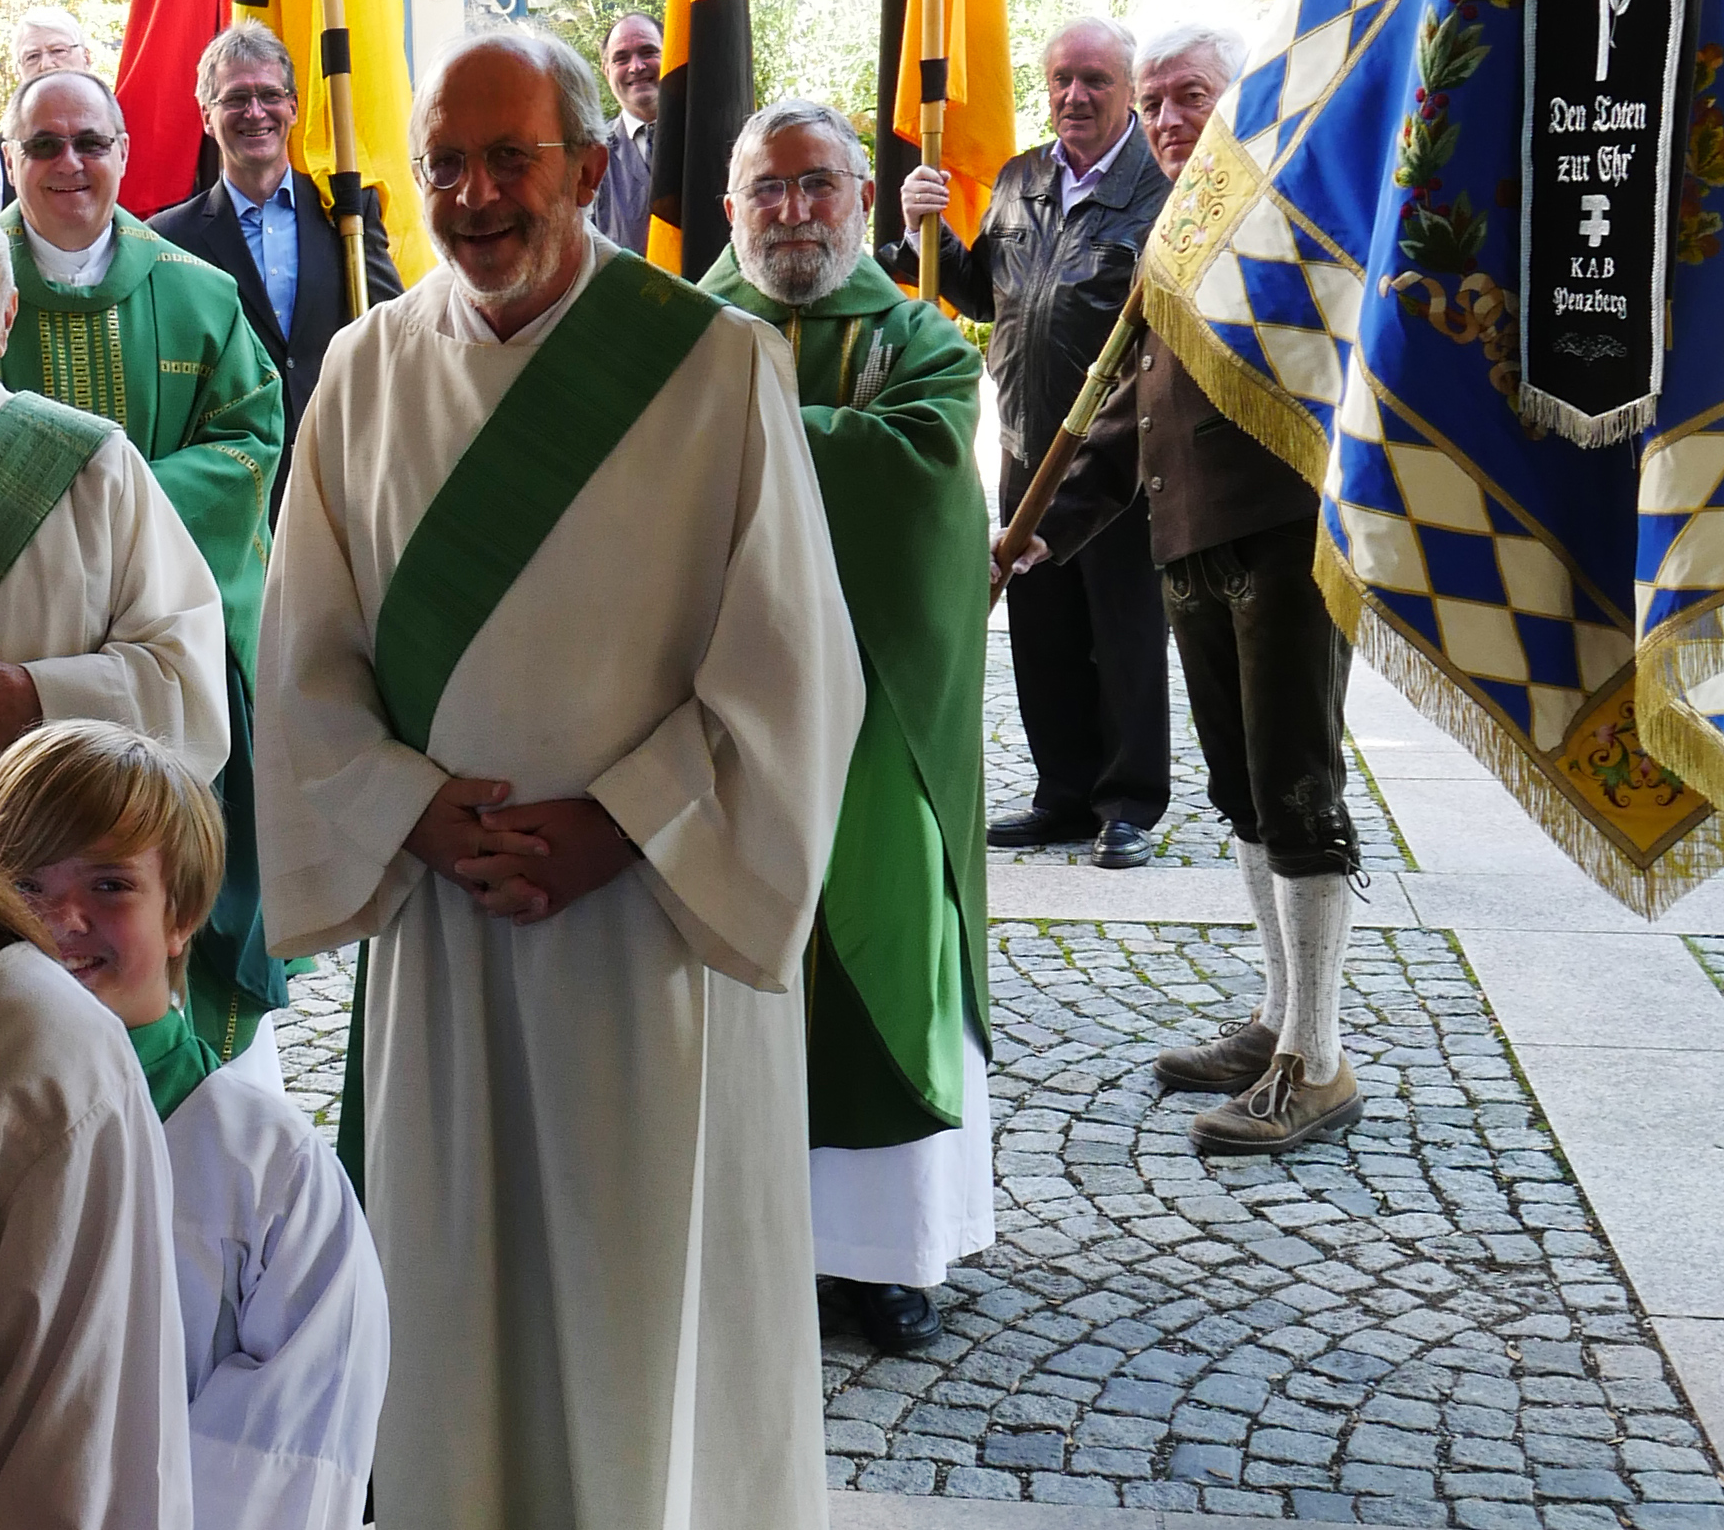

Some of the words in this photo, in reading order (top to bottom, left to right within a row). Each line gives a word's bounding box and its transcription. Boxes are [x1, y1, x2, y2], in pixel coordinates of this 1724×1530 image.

[1549, 97, 1586, 133] Den
[1592, 95, 1646, 131] Toten
[1558, 155, 1590, 182] zur
[1571, 257, 1614, 278] KAB
[1553, 287, 1626, 319] Penzberg
